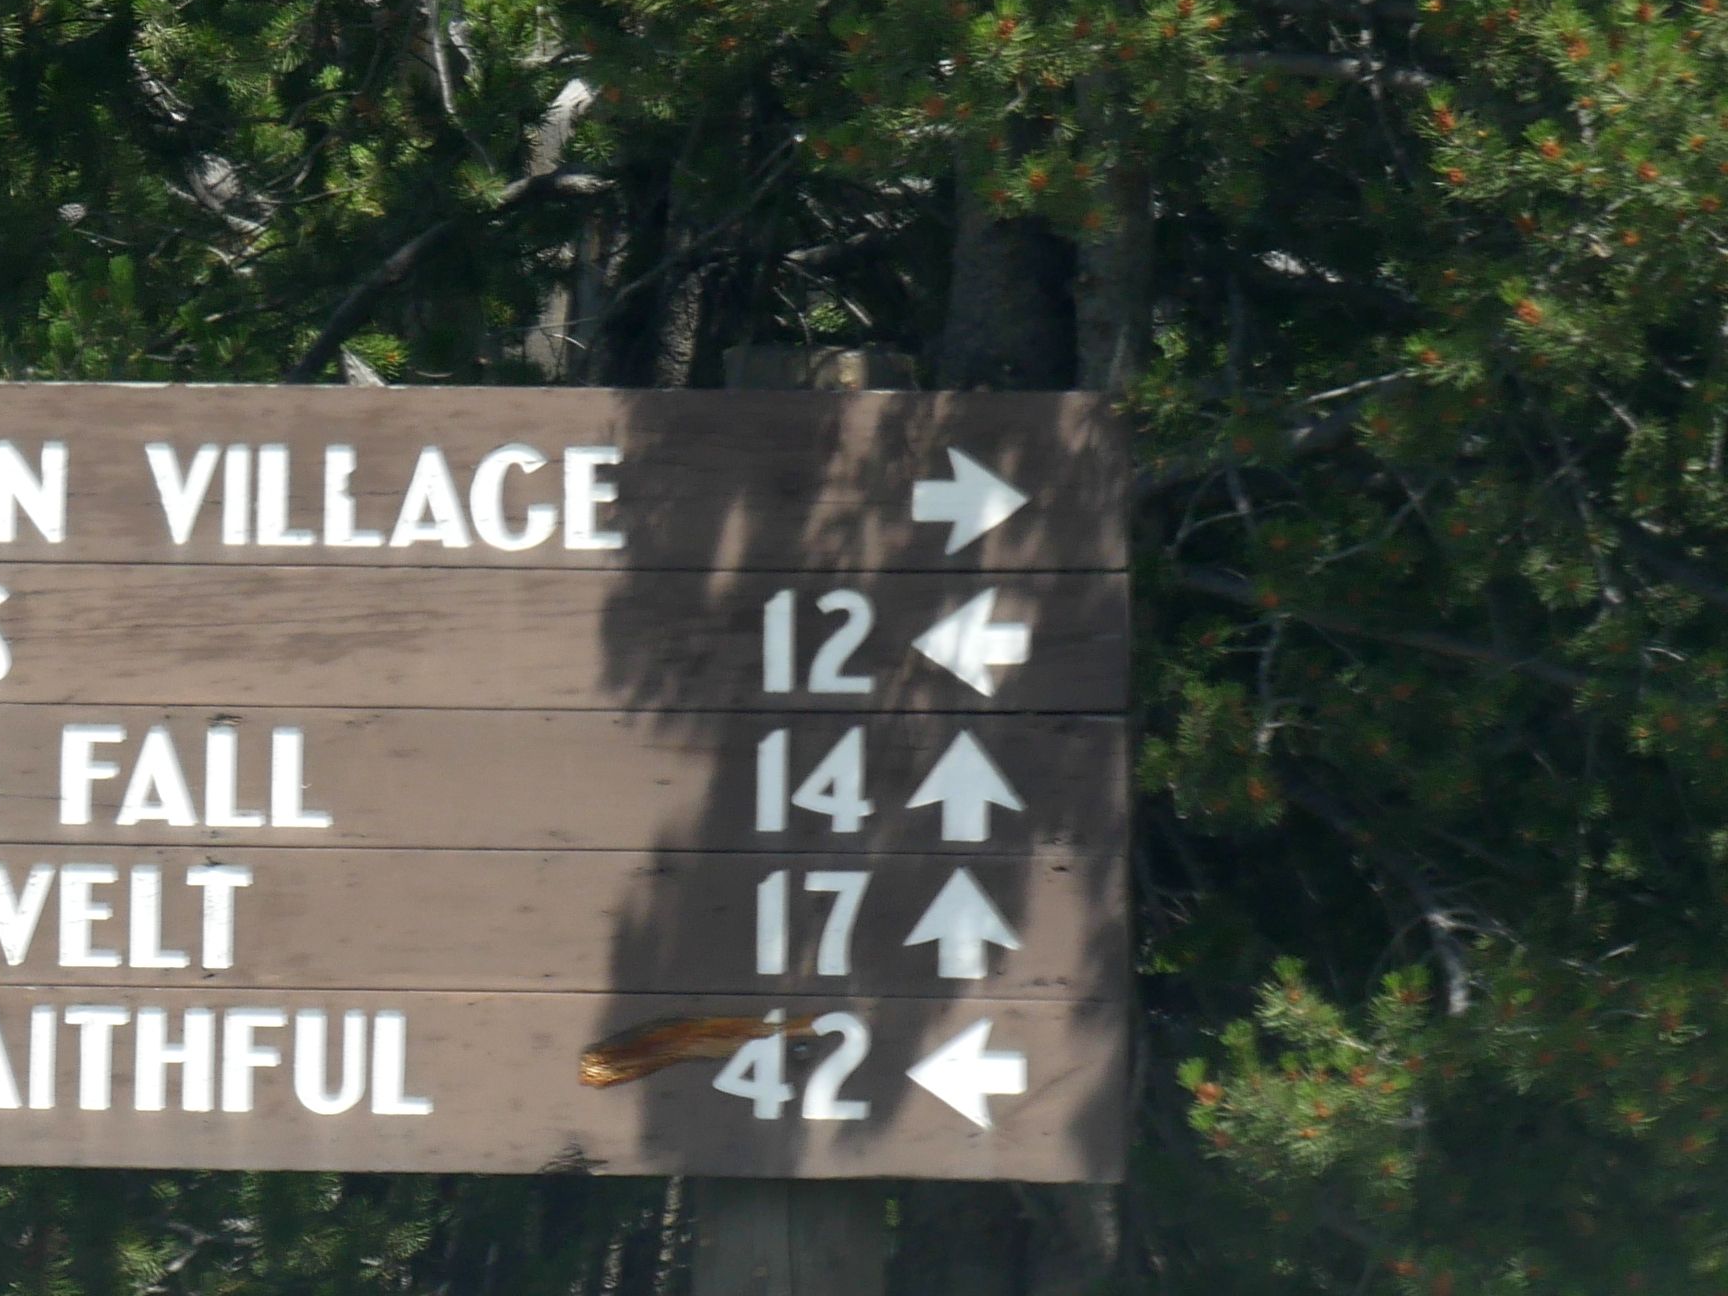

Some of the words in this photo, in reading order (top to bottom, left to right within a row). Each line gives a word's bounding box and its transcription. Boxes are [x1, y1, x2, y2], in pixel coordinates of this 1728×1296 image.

[144, 442, 624, 552] VILLAGE
[763, 589, 876, 694] 12
[58, 723, 334, 829] FALL
[755, 726, 875, 834] 14
[756, 870, 872, 977] 17
[712, 1008, 872, 1121] 42
